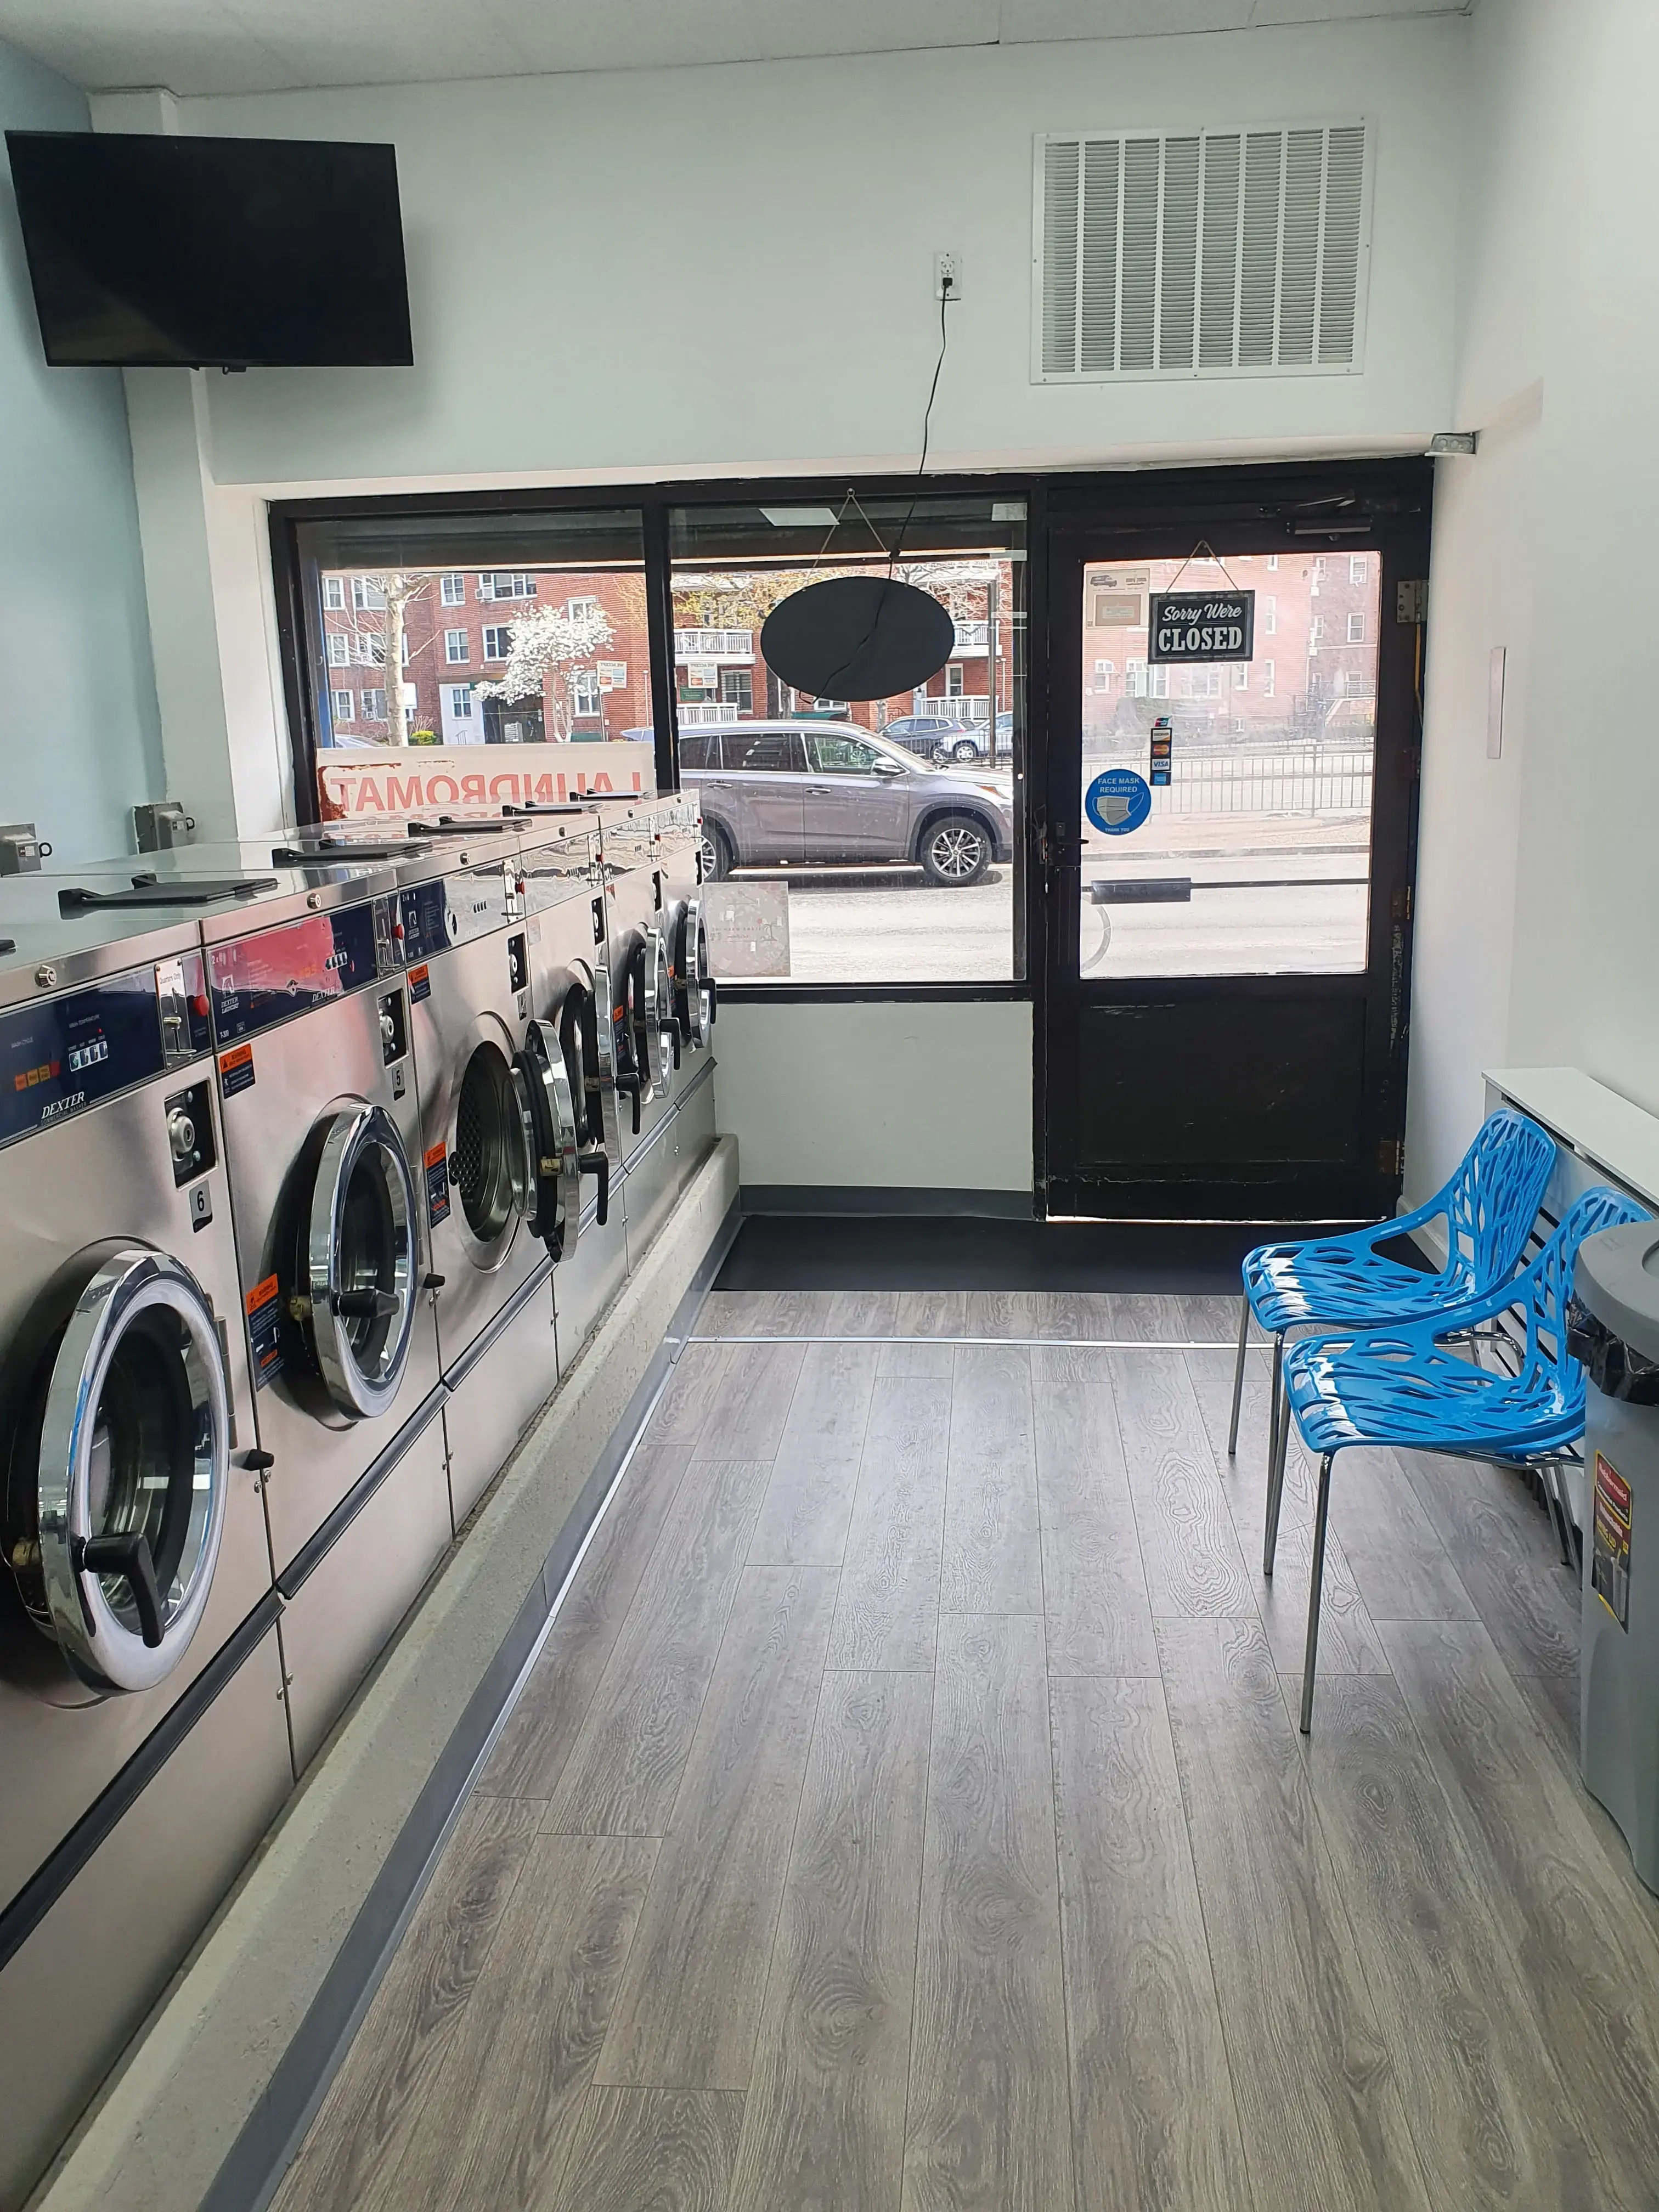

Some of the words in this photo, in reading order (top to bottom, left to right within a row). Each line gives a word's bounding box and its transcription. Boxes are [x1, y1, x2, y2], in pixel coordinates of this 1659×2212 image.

[1163, 606, 1201, 625] Sorry
[1159, 627, 1242, 652] CLOSED
[312, 987, 335, 1003] DEXTER
[396, 1070, 400, 1086] 5
[41, 1091, 84, 1119] DEXTER
[197, 1190, 205, 1211] 6
